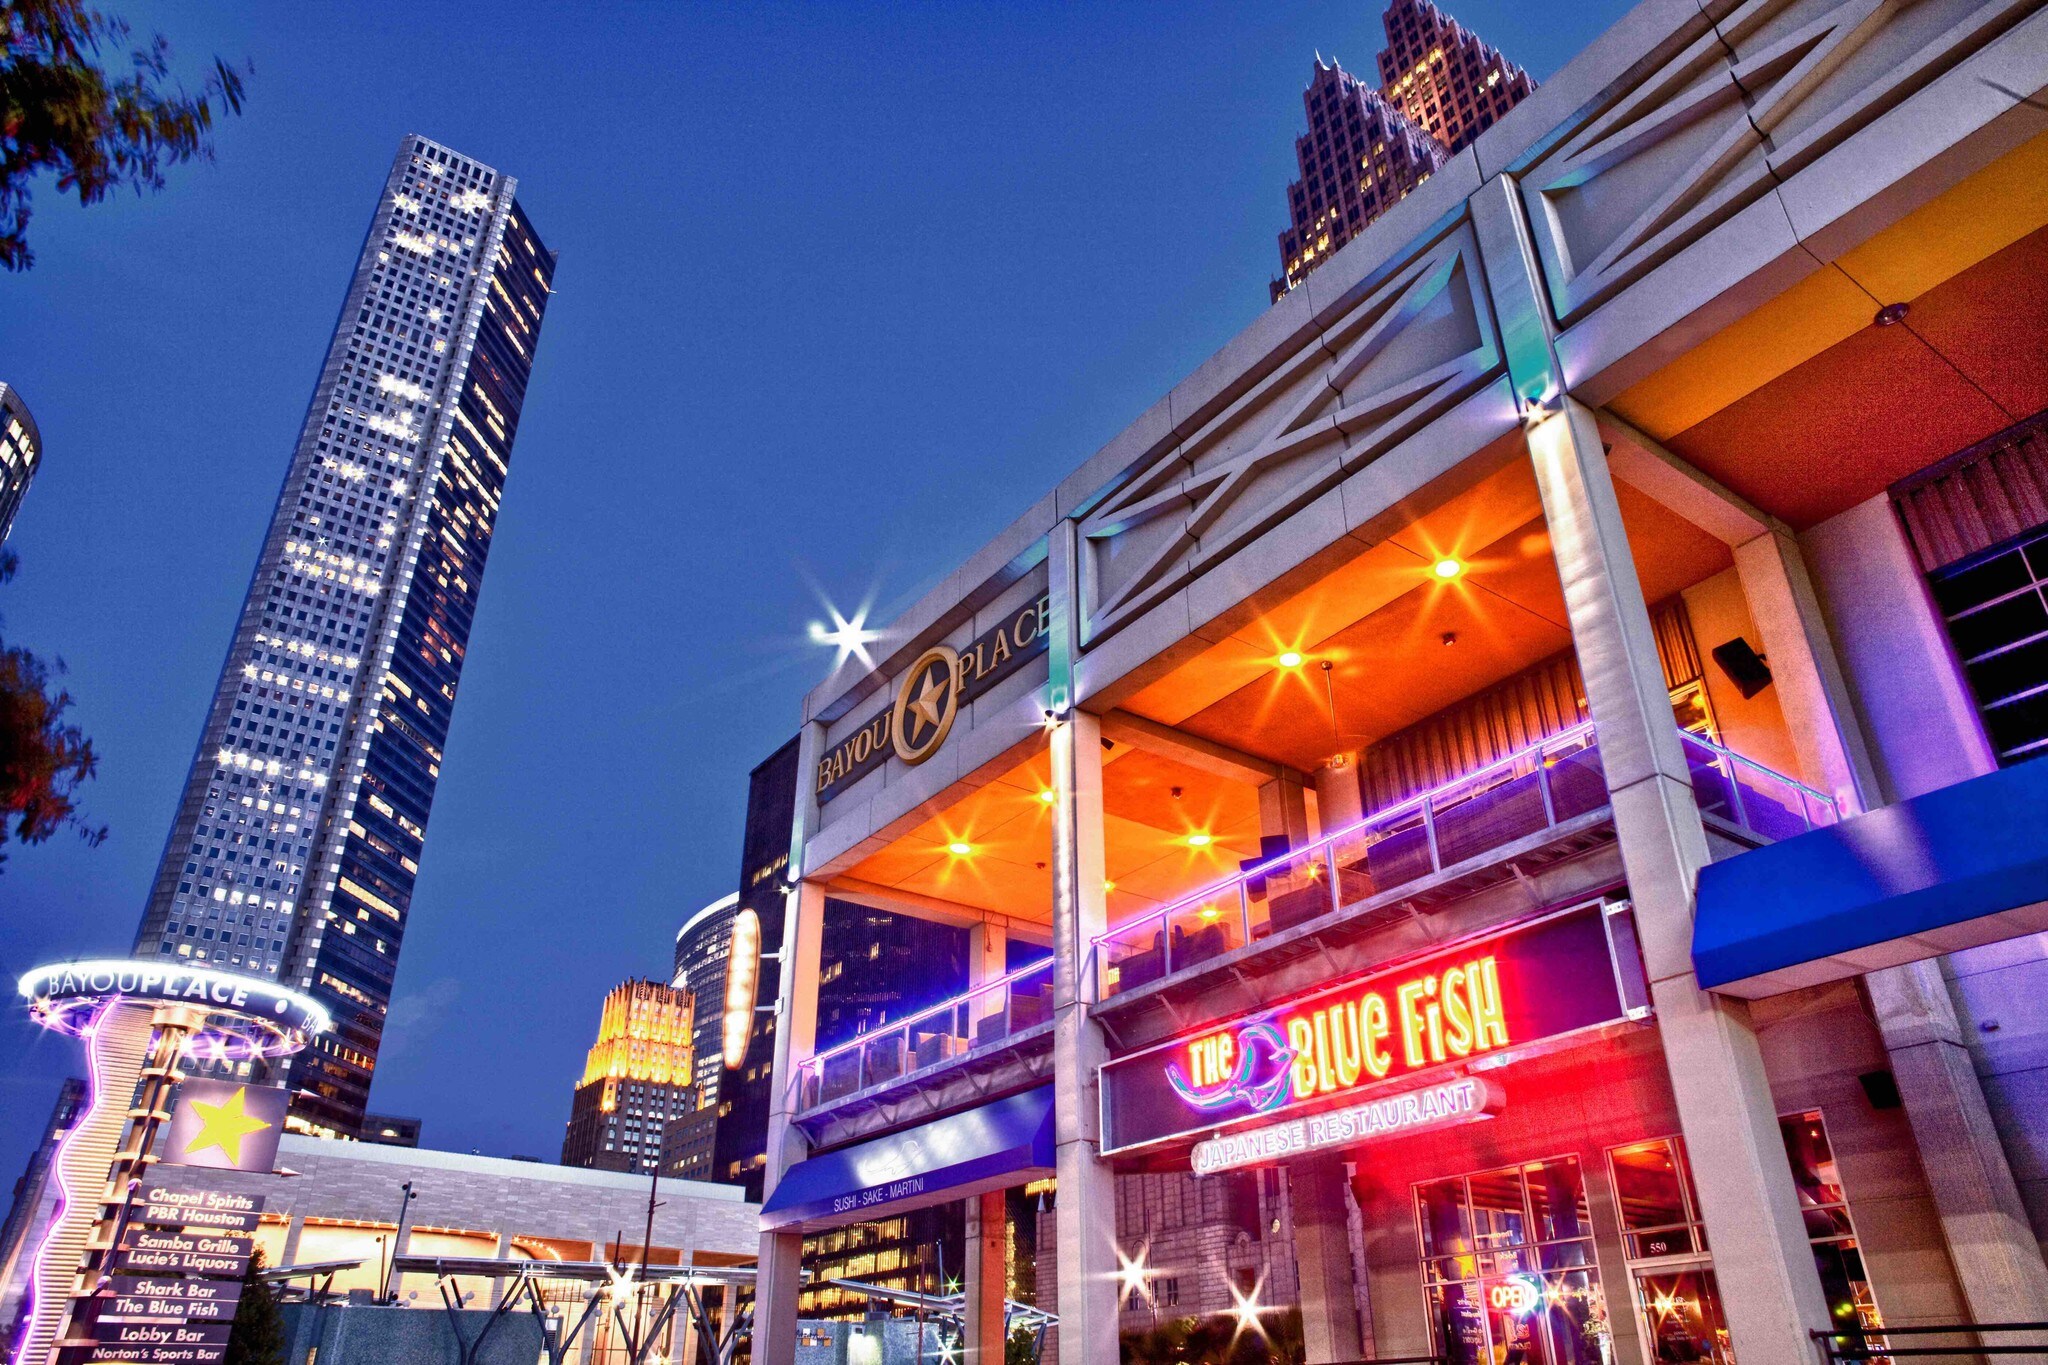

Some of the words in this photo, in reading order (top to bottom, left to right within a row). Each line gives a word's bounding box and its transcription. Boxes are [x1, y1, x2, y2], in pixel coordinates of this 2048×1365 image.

[817, 711, 893, 793] BAYOU
[1199, 1127, 1304, 1169] JAPANESE
[1309, 1082, 1476, 1145] RESTAURANT
[150, 1188, 204, 1206] Chapel
[207, 1193, 254, 1210] Spirits
[833, 1194, 857, 1212] SUSHI
[862, 1187, 883, 1206] SAKE
[889, 1177, 924, 1199] MARTINI
[147, 1206, 178, 1221] PBR
[181, 1209, 245, 1226] Houston
[138, 1234, 193, 1251] Samba
[198, 1239, 240, 1254] Grille
[1650, 1242, 1667, 1254] 550
[128, 1251, 179, 1266] Lucie's
[182, 1255, 239, 1271] Liquors
[134, 1281, 184, 1296] Shark
[187, 1284, 217, 1298] Bar
[1491, 1285, 1530, 1309] OPEN
[115, 1299, 143, 1313] The
[148, 1301, 184, 1315] Blue
[187, 1302, 219, 1317] Fish
[120, 1327, 172, 1344] Lobby
[175, 1329, 205, 1342] Bar
[92, 1347, 149, 1359] Norton's
[152, 1348, 194, 1362] Sports
[196, 1349, 220, 1360] Bar
